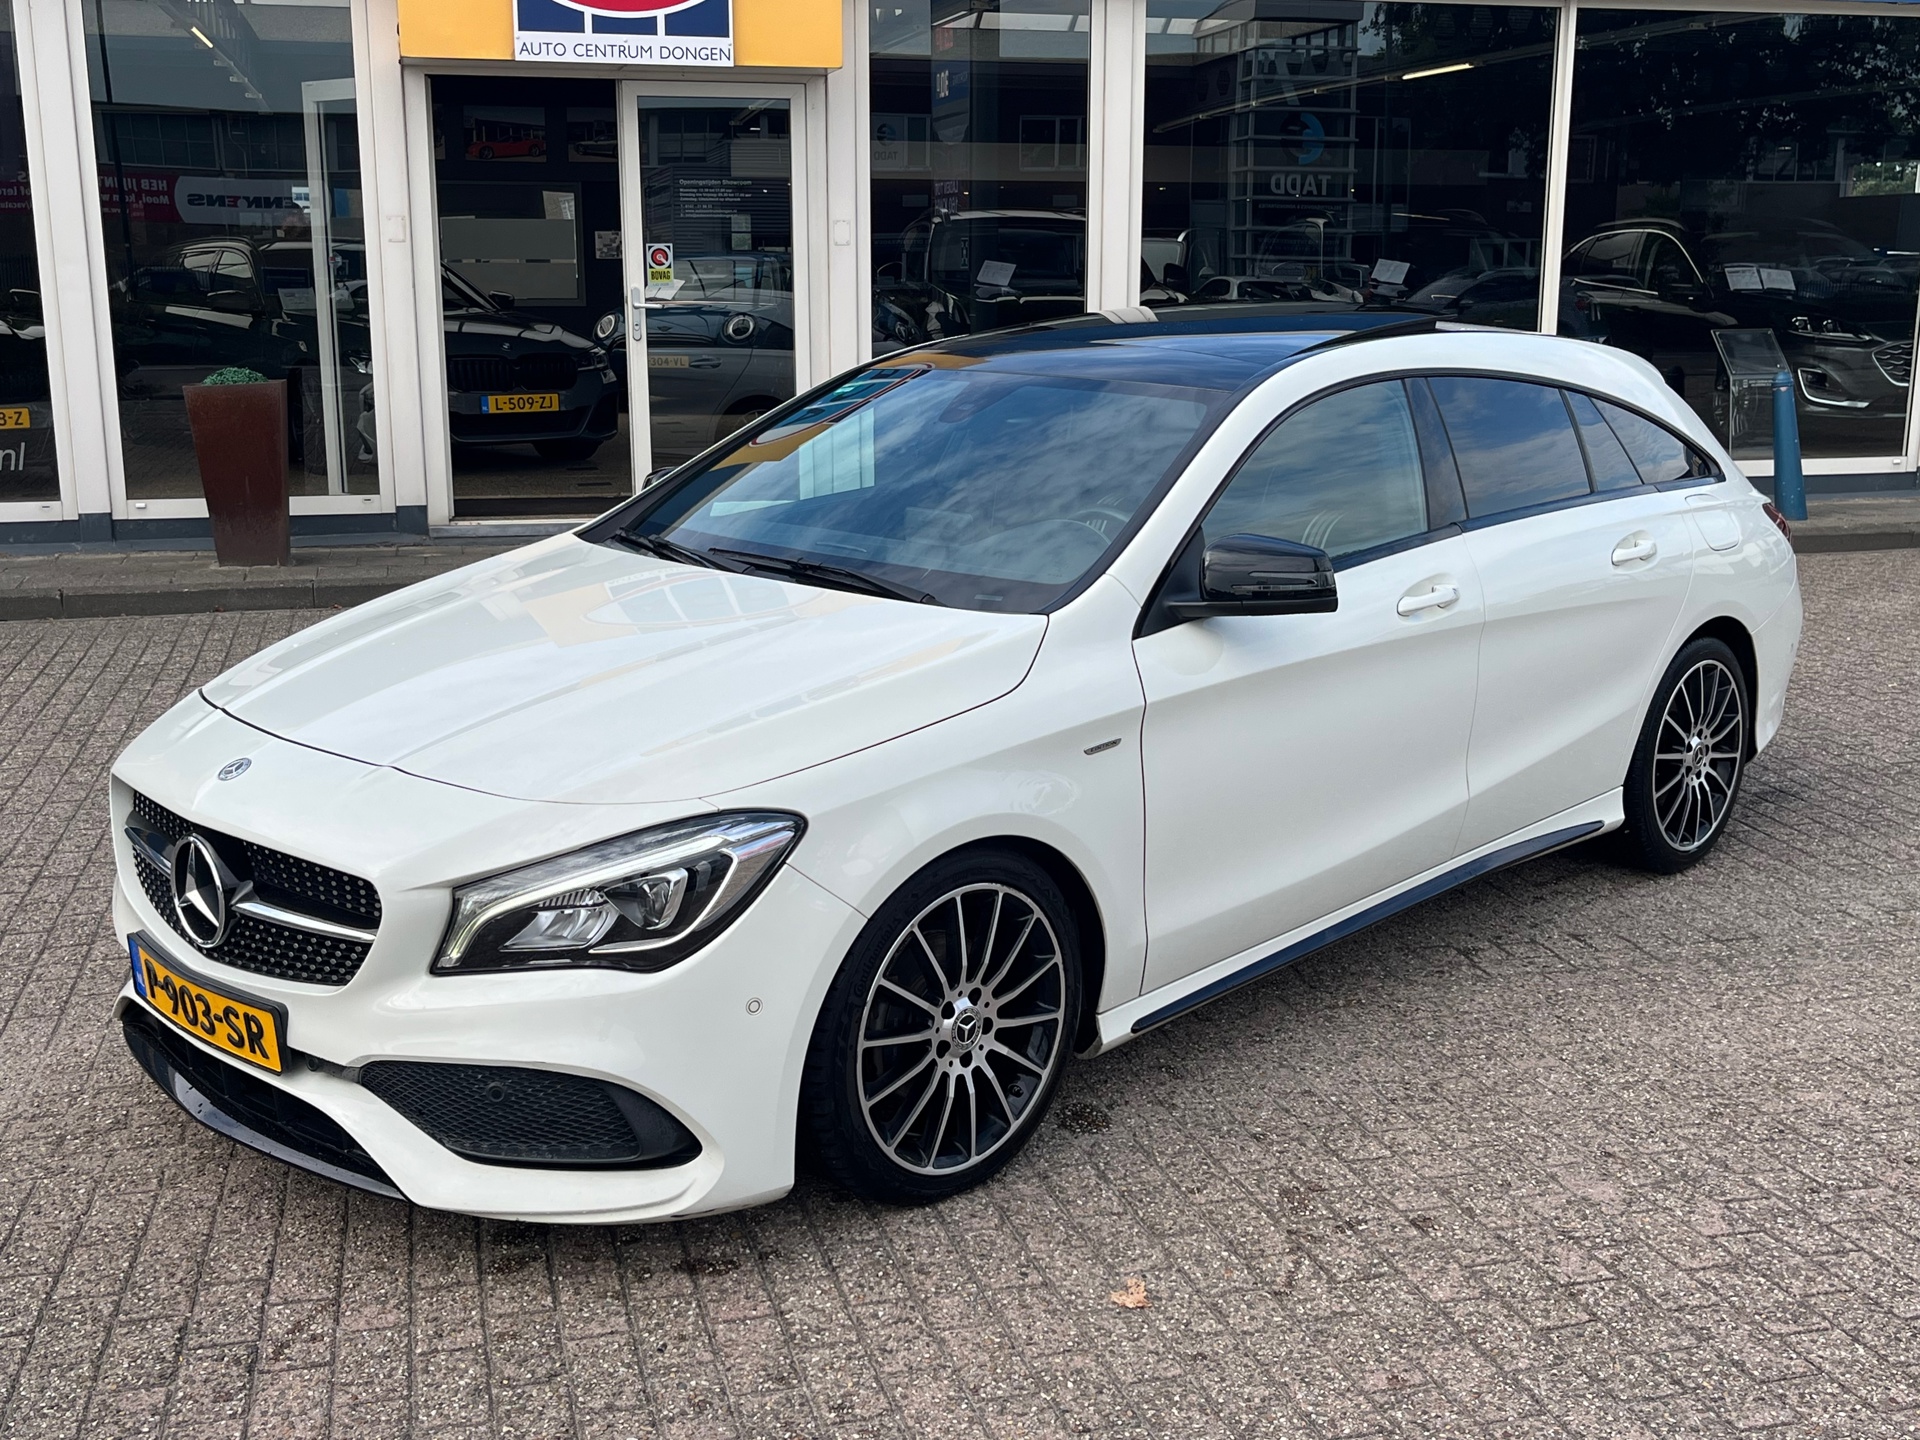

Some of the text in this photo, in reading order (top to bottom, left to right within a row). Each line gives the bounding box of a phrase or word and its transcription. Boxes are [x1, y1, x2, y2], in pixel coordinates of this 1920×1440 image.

[519, 41, 732, 62] AUTO CENTRUM DONGEN
[650, 270, 671, 281] BOVAG
[494, 396, 553, 411] L-509-ZJ
[144, 957, 270, 1060] P-903-SR
